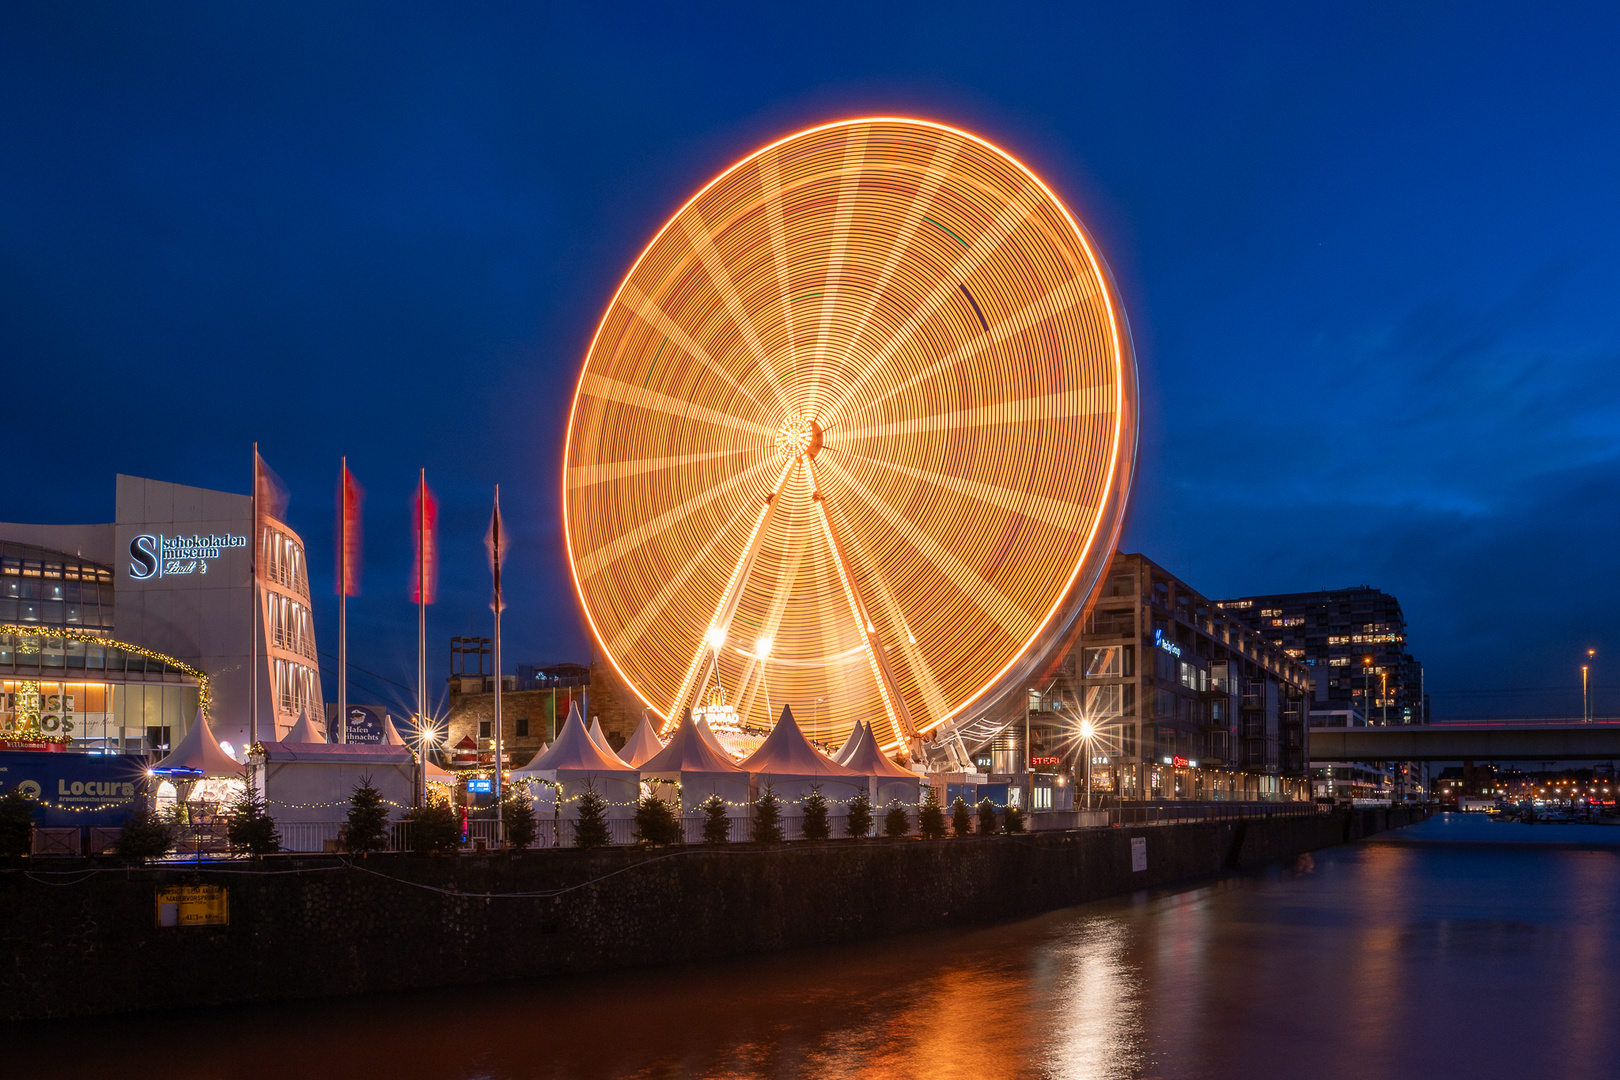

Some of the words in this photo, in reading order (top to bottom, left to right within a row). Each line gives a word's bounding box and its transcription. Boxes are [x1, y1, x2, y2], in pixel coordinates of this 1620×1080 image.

[163, 533, 246, 549] schokoladen
[129, 534, 157, 580] S
[163, 547, 219, 560] museum
[163, 561, 197, 574] Lindt
[693, 706, 707, 715] DAS
[346, 725, 369, 734] Hafen
[335, 732, 379, 741] ihnachts
[1092, 756, 1108, 765] STA
[58, 779, 135, 796] Locura
